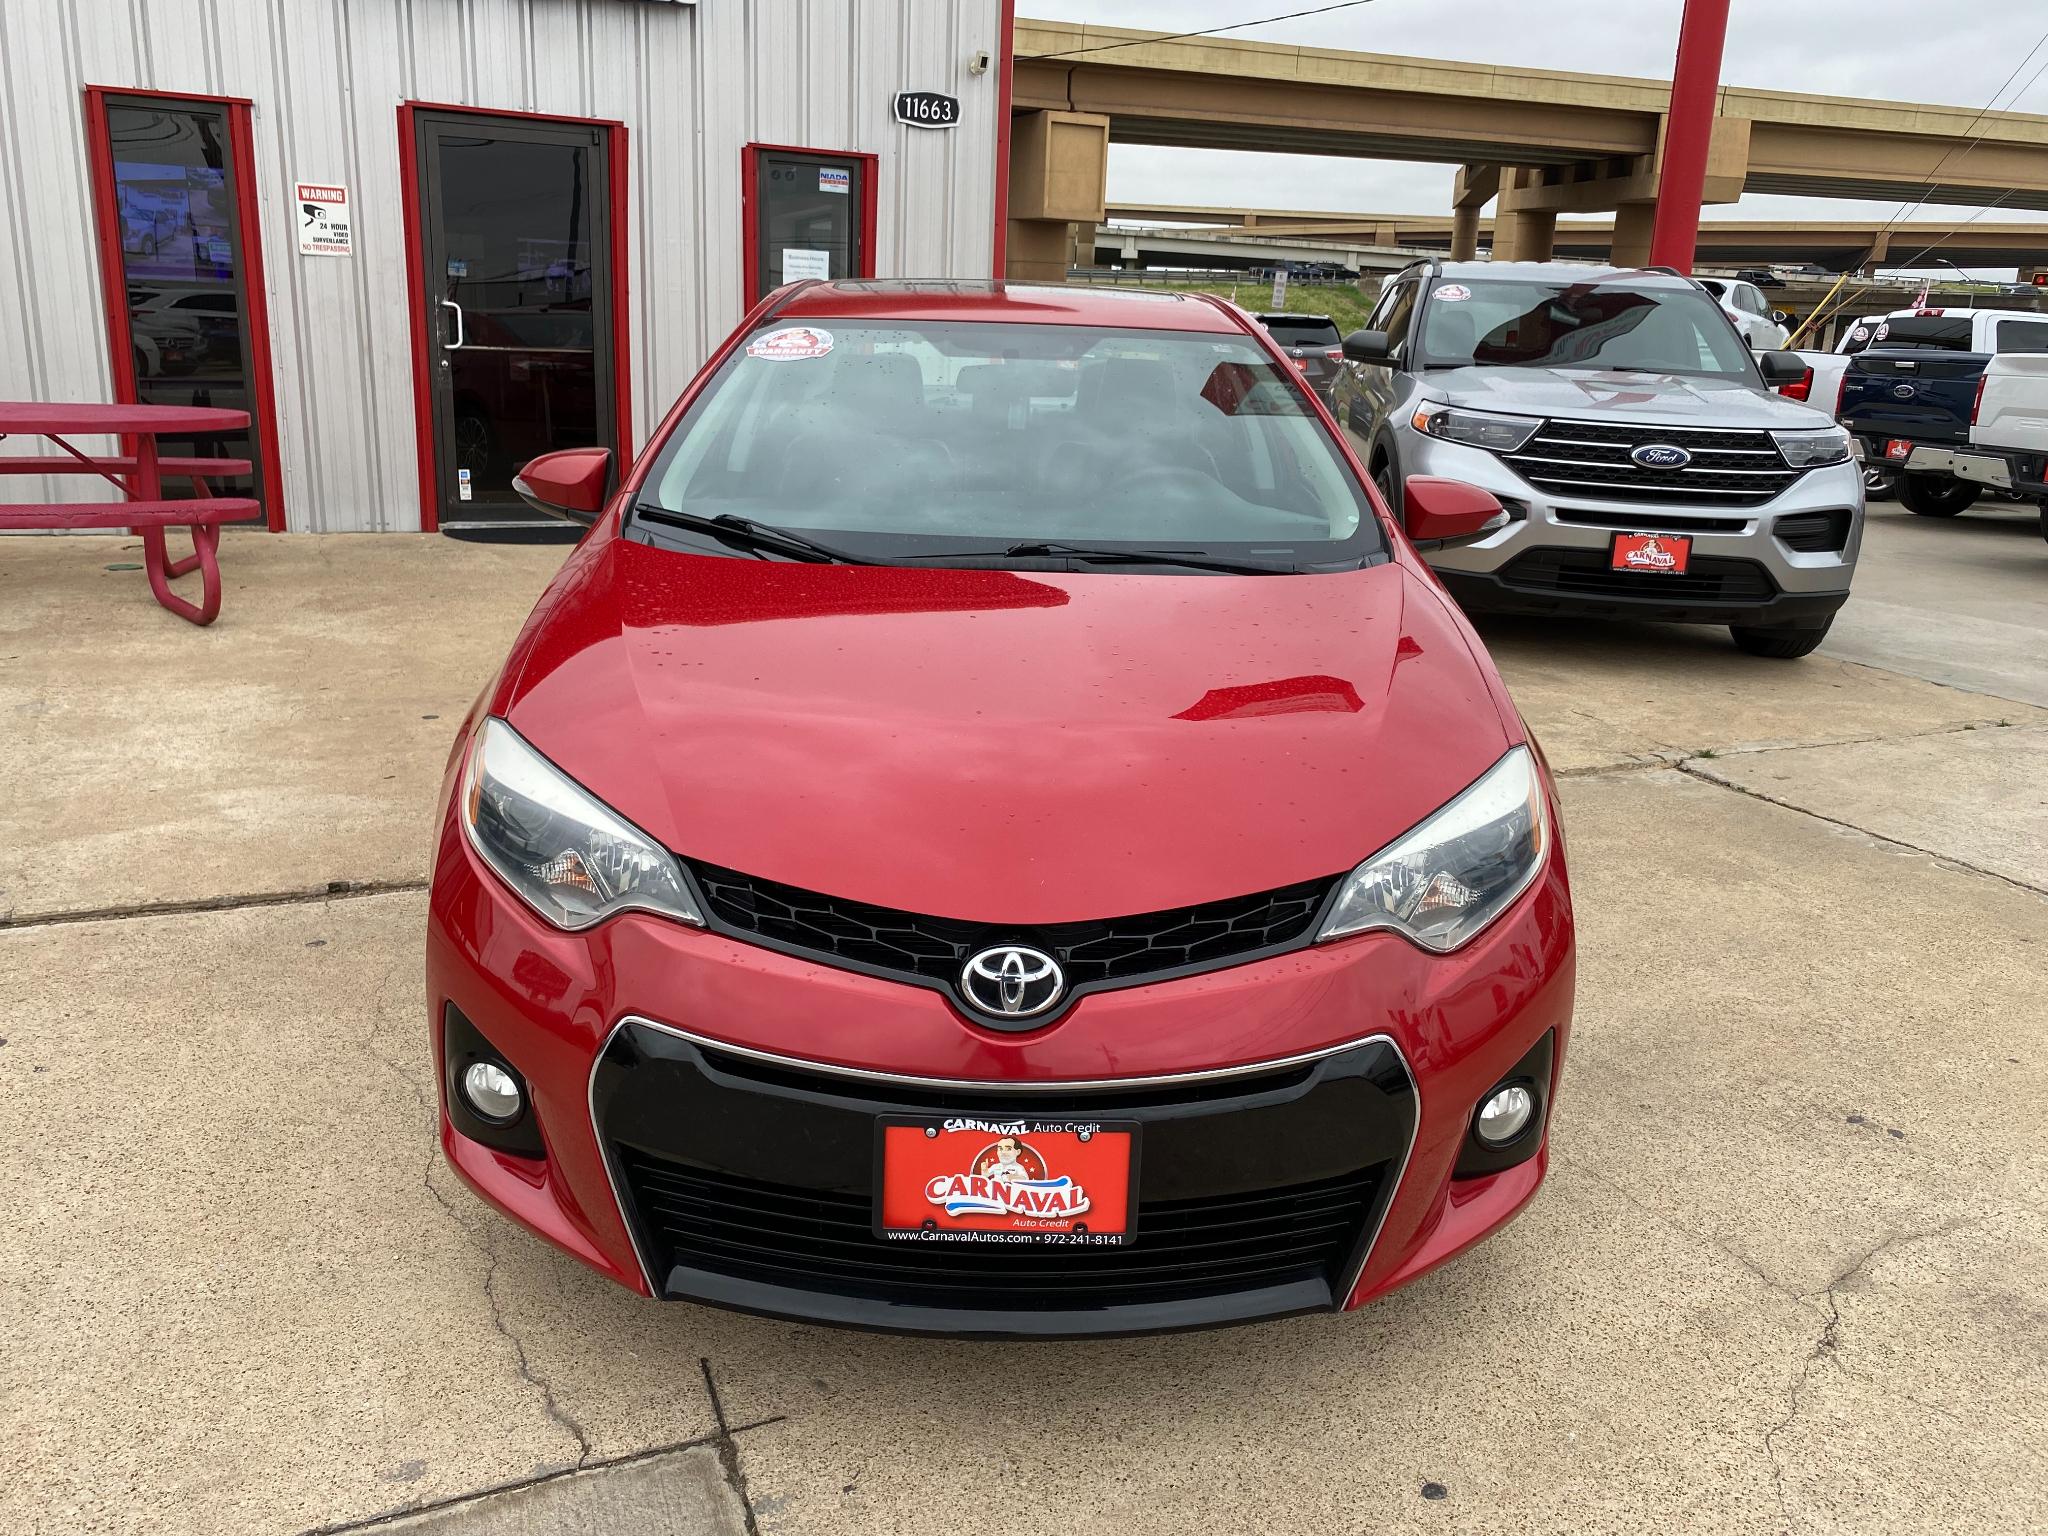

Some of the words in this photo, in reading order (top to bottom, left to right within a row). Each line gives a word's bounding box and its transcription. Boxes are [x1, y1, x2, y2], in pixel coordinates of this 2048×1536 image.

[905, 97, 951, 121] 11663
[820, 172, 848, 181] NIADA
[301, 188, 343, 201] WARNING
[331, 223, 348, 231] HOUR
[302, 243, 312, 251] NO
[312, 244, 351, 253] TRESPASSING
[1645, 449, 1678, 463] Ford
[1626, 551, 1676, 566] CARNAVAL
[943, 1118, 1030, 1136] CARNAVAL
[1033, 1123, 1062, 1133] Auto
[1065, 1123, 1101, 1133] Credit
[925, 1174, 1091, 1218] CARNAVAL
[1012, 1218, 1036, 1228] Auto
[1039, 1218, 1070, 1228] Credit
[887, 1230, 1032, 1244] www.CarnavalAutos.com
[1043, 1233, 1122, 1245] 972-241-8141
